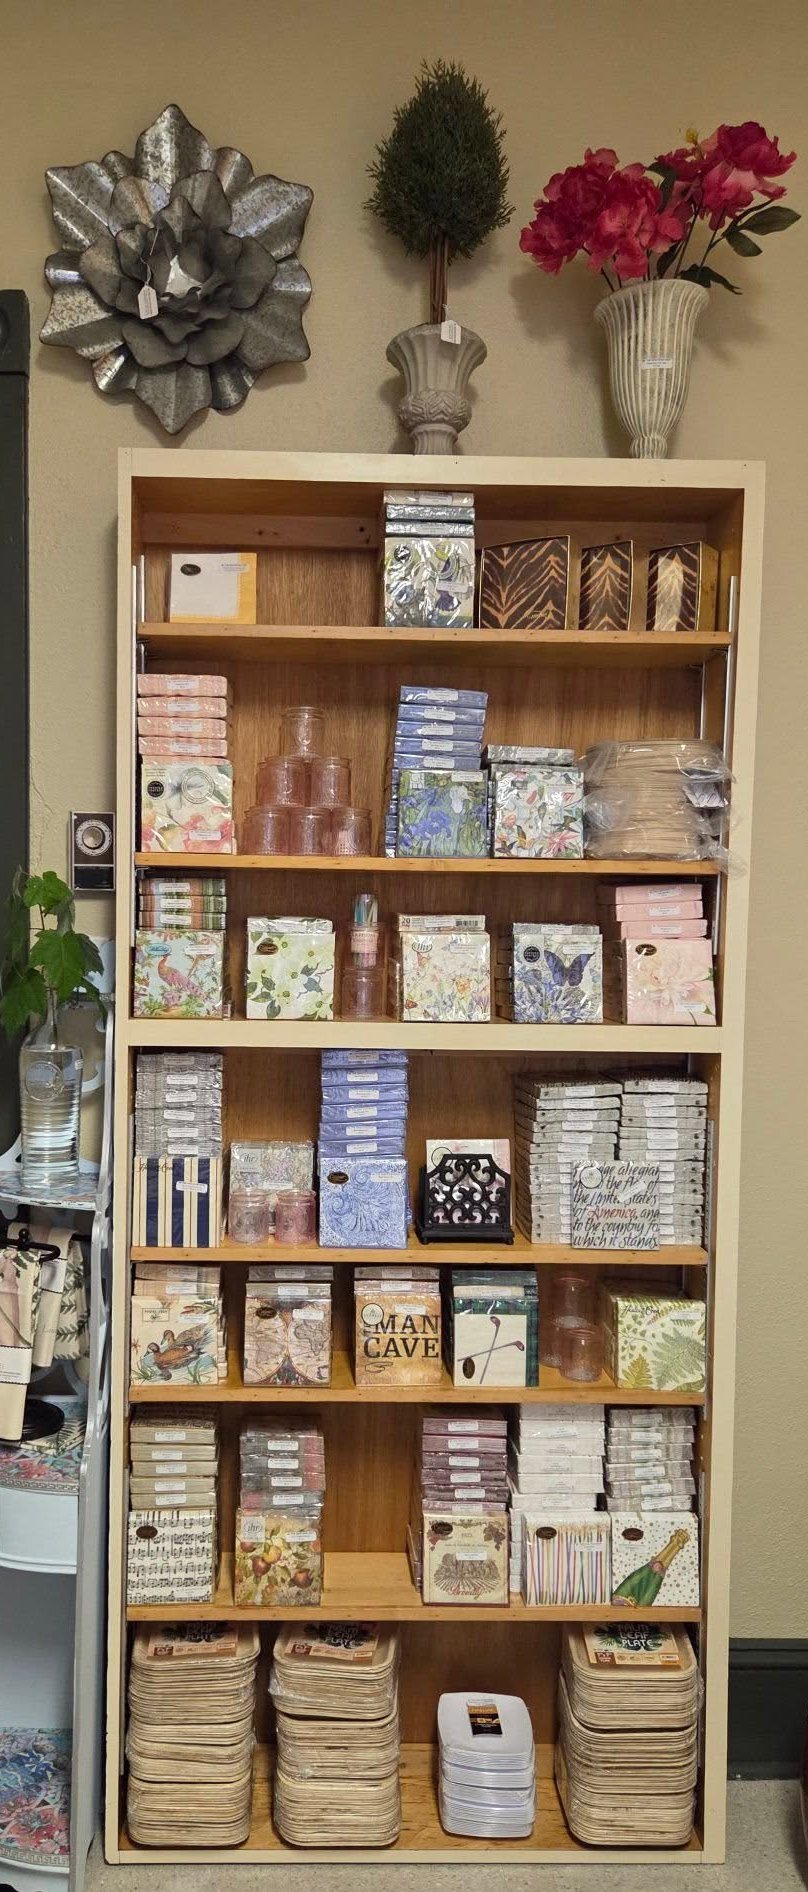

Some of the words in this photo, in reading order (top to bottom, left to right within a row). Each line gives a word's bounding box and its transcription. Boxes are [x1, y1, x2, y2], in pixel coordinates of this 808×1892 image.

[573, 1188, 590, 1204] the
[572, 1203, 591, 1220] of
[573, 1218, 583, 1231] to
[585, 1218, 600, 1232] the
[573, 1231, 607, 1248] which
[609, 1232, 618, 1247] it
[373, 1314, 441, 1335] MAN
[363, 1337, 440, 1359] CAVE
[619, 1631, 650, 1639] LEAF
[621, 1639, 654, 1647] PLATE
